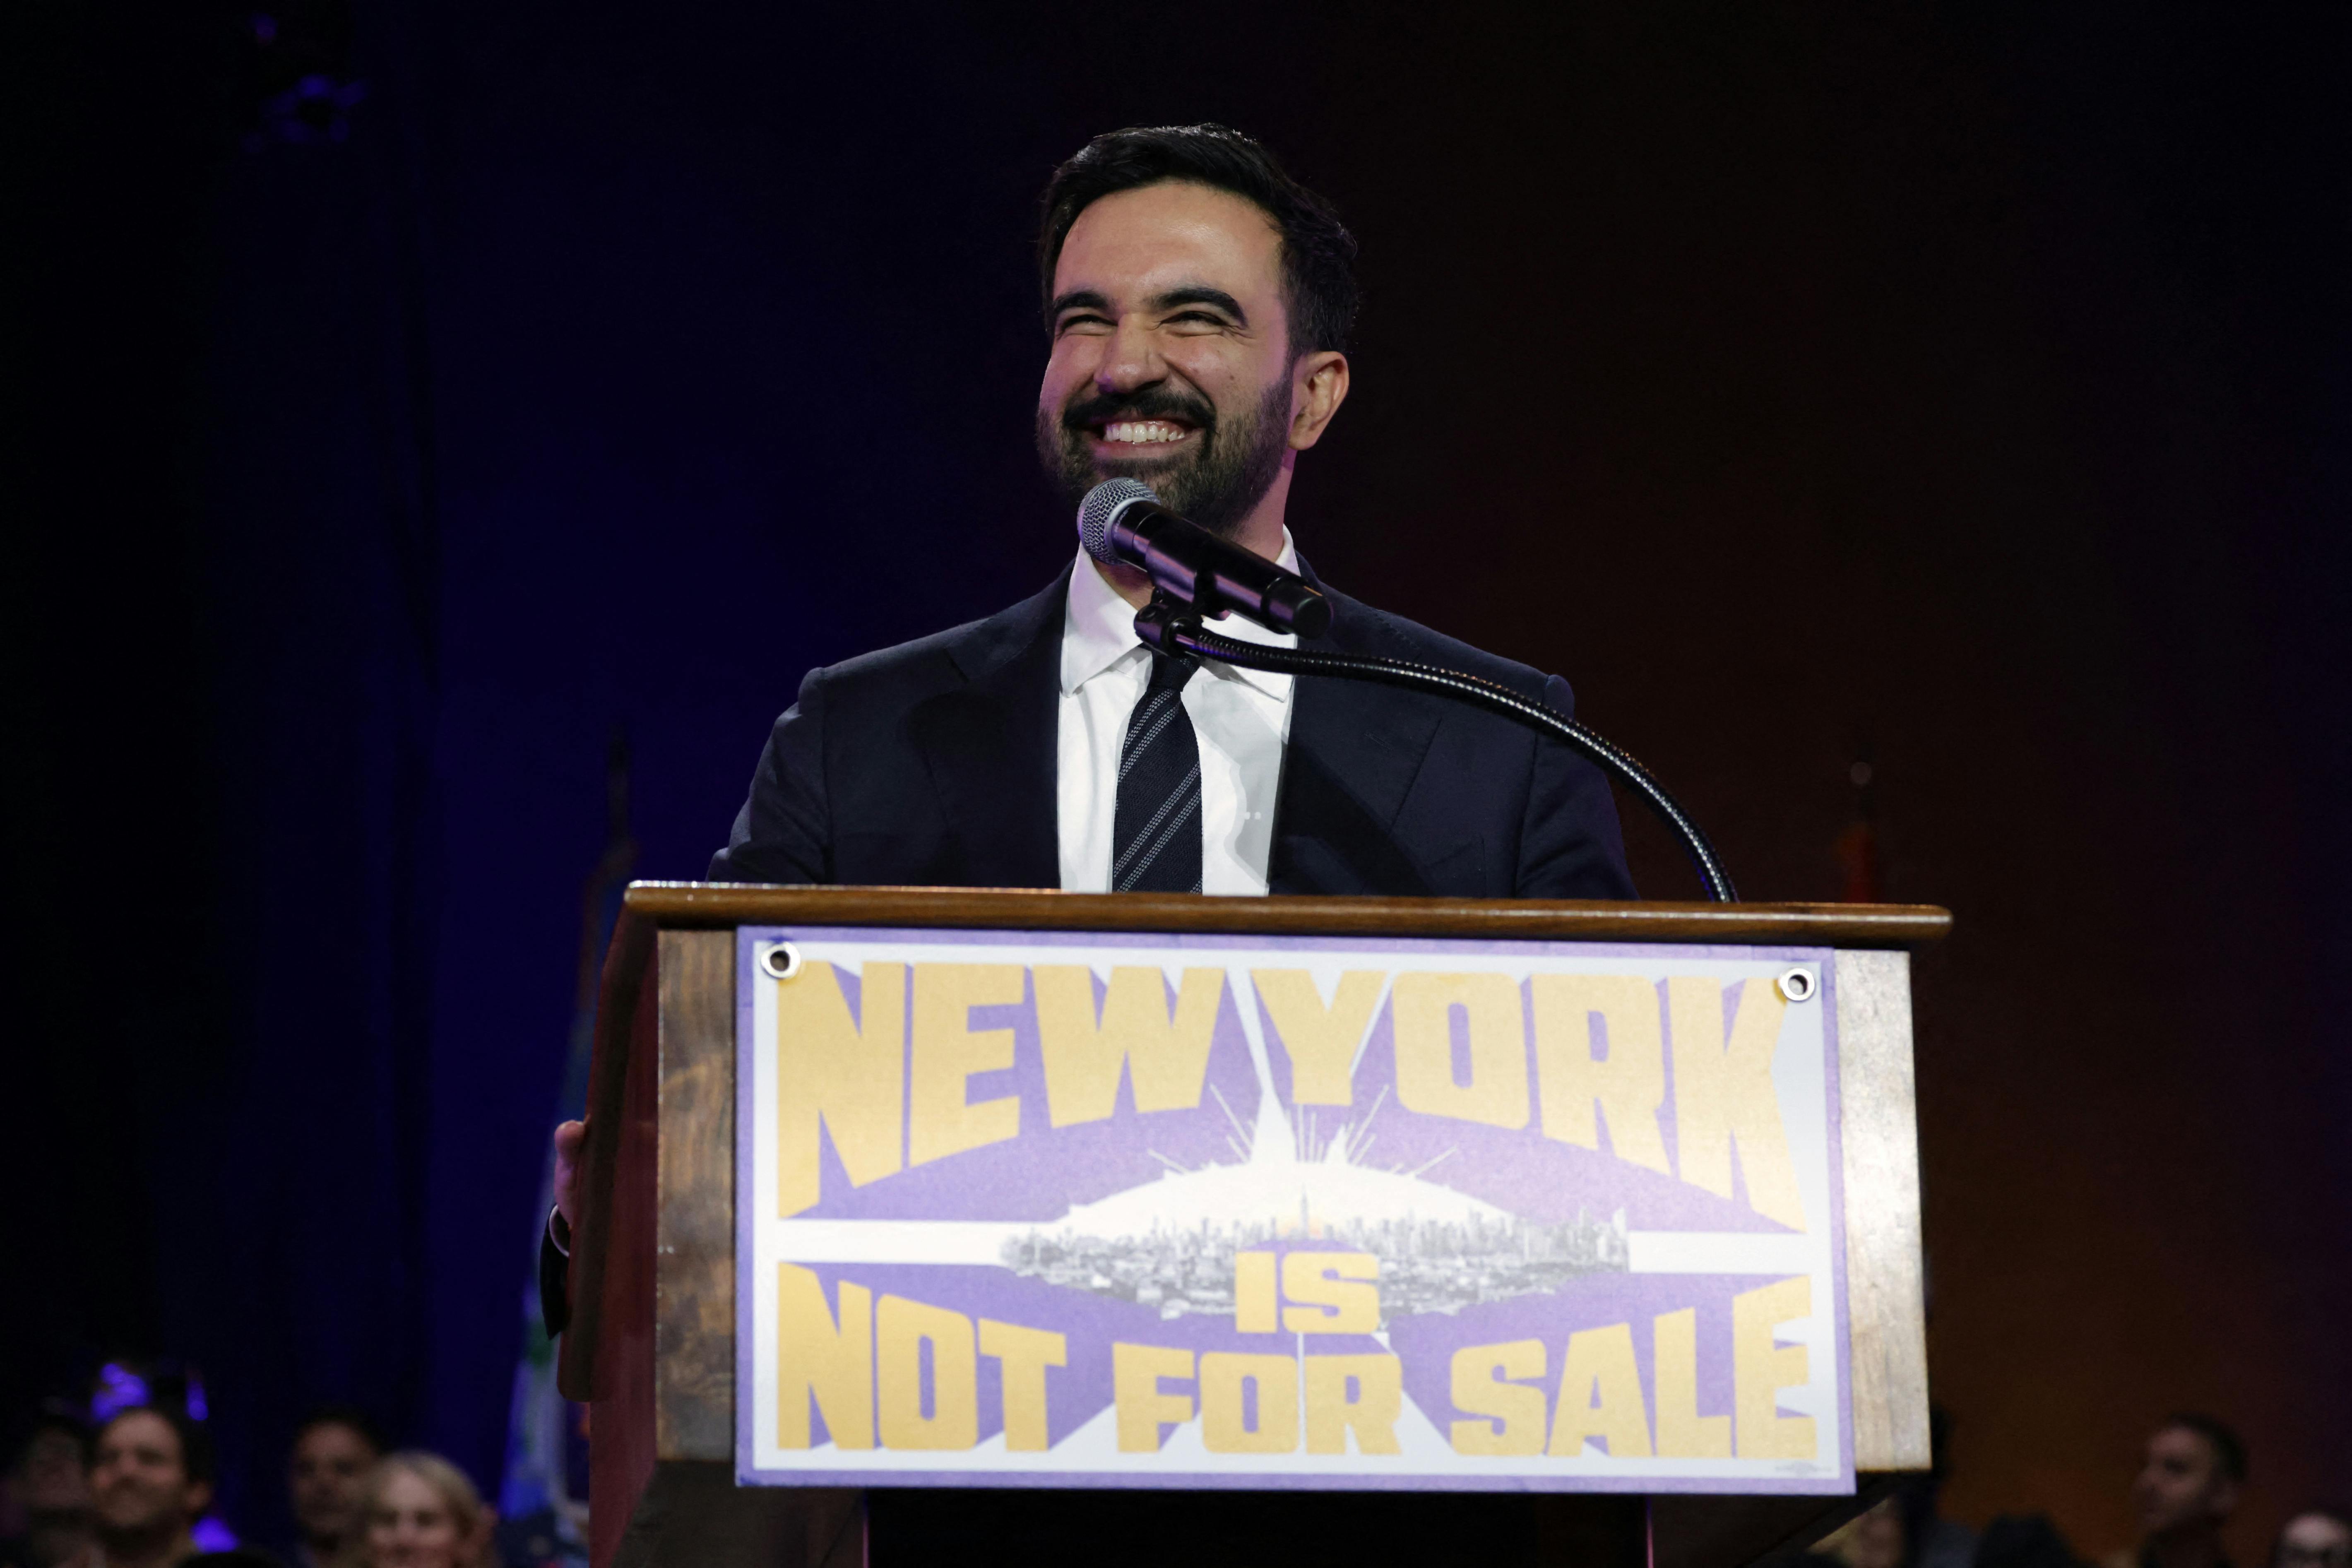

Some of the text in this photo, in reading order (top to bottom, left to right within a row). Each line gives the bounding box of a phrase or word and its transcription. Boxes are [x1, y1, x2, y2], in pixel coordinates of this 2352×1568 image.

[777, 960, 1807, 1233] NEW YORK
[777, 1262, 1817, 1459] NOT FOR SALE
[1235, 1251, 1380, 1334] IS
